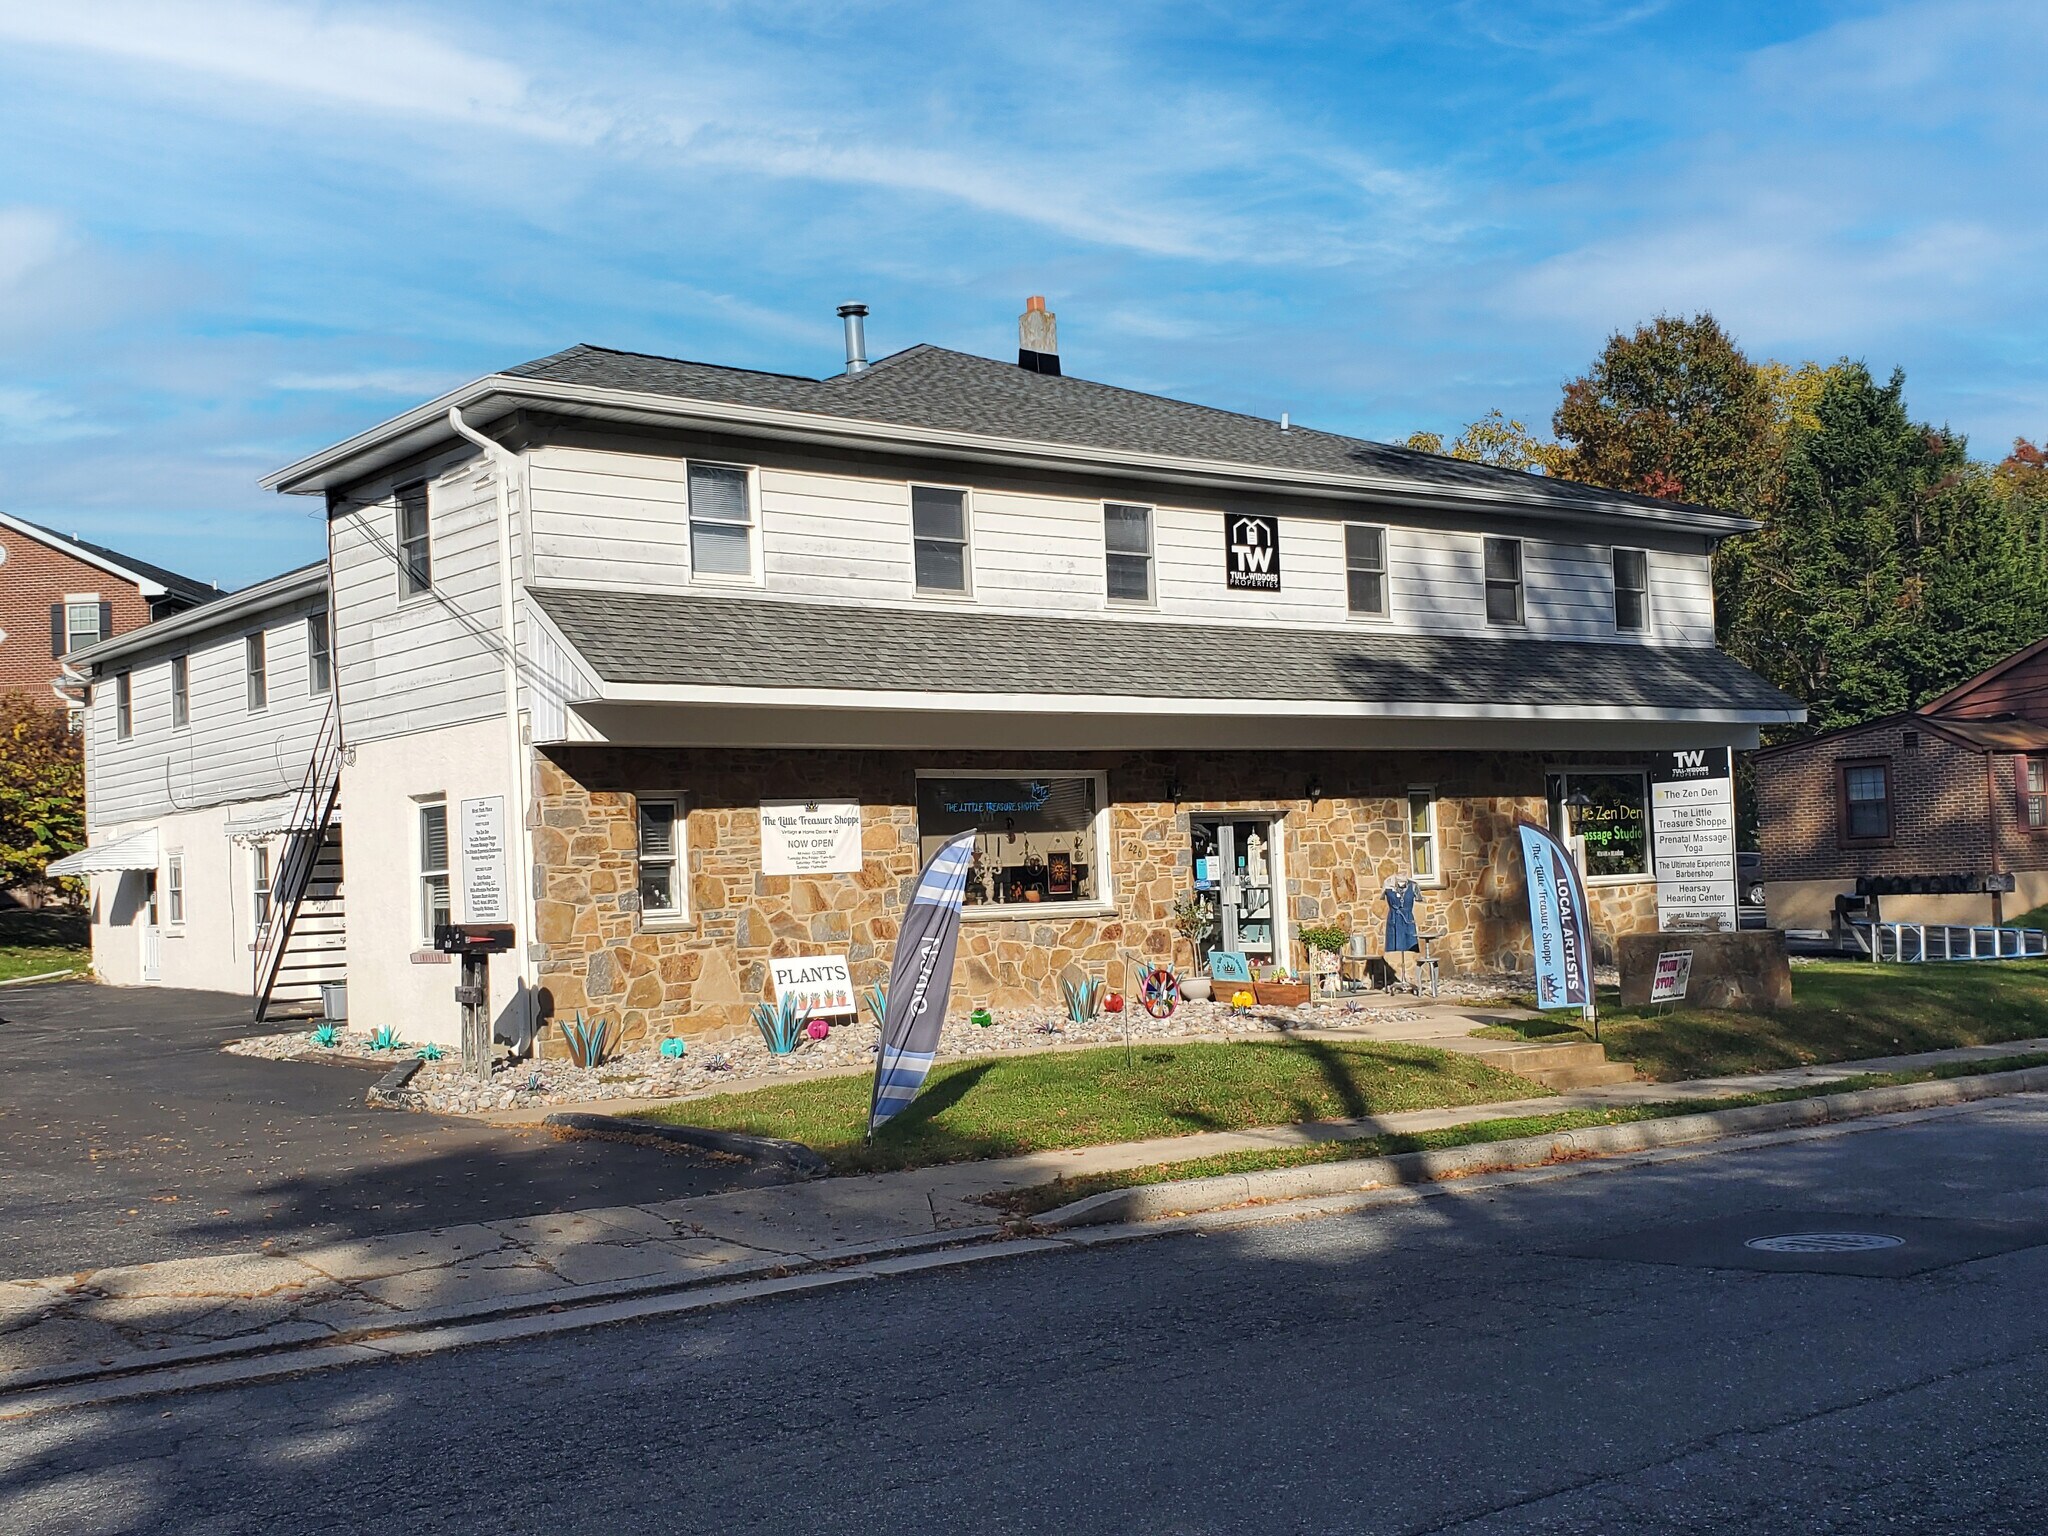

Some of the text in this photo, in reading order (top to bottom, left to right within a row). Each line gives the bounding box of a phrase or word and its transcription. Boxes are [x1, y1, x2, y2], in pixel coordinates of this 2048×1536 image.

[1231, 545, 1273, 573] TW
[1230, 571, 1278, 582] TULL-WIDDOES
[1230, 579, 1278, 588] PROPERTIES
[1673, 750, 1705, 768] TW
[1664, 788, 1718, 799] The Zen Den
[944, 803, 959, 812] THE
[959, 802, 984, 812] LITTLE
[1595, 805, 1618, 820] Zen
[1620, 805, 1643, 819] Den
[1672, 808, 1712, 818] The Little
[762, 815, 859, 828] The Little Treasure Shoppe
[1658, 818, 1727, 829] Treasure Shoppe
[1584, 825, 1643, 845] assage Studio
[1659, 834, 1691, 844] Prenatal
[788, 839, 834, 848] NOW OPEN
[1683, 844, 1703, 854] Yoga
[1128, 841, 1143, 858] 226
[1531, 843, 1541, 862] The
[1659, 859, 1731, 870] The Ultimate Experience
[1675, 870, 1714, 878] Barbershop
[1679, 885, 1711, 893] Hearsay
[1666, 893, 1725, 903] Hearing Center
[1538, 889, 1549, 931] Treasure
[1556, 878, 1579, 990] LOCAL ARTISTS
[1541, 933, 1553, 967] Shoppe
[776, 965, 847, 985] PLANTS
[1655, 976, 1675, 990] STOP
